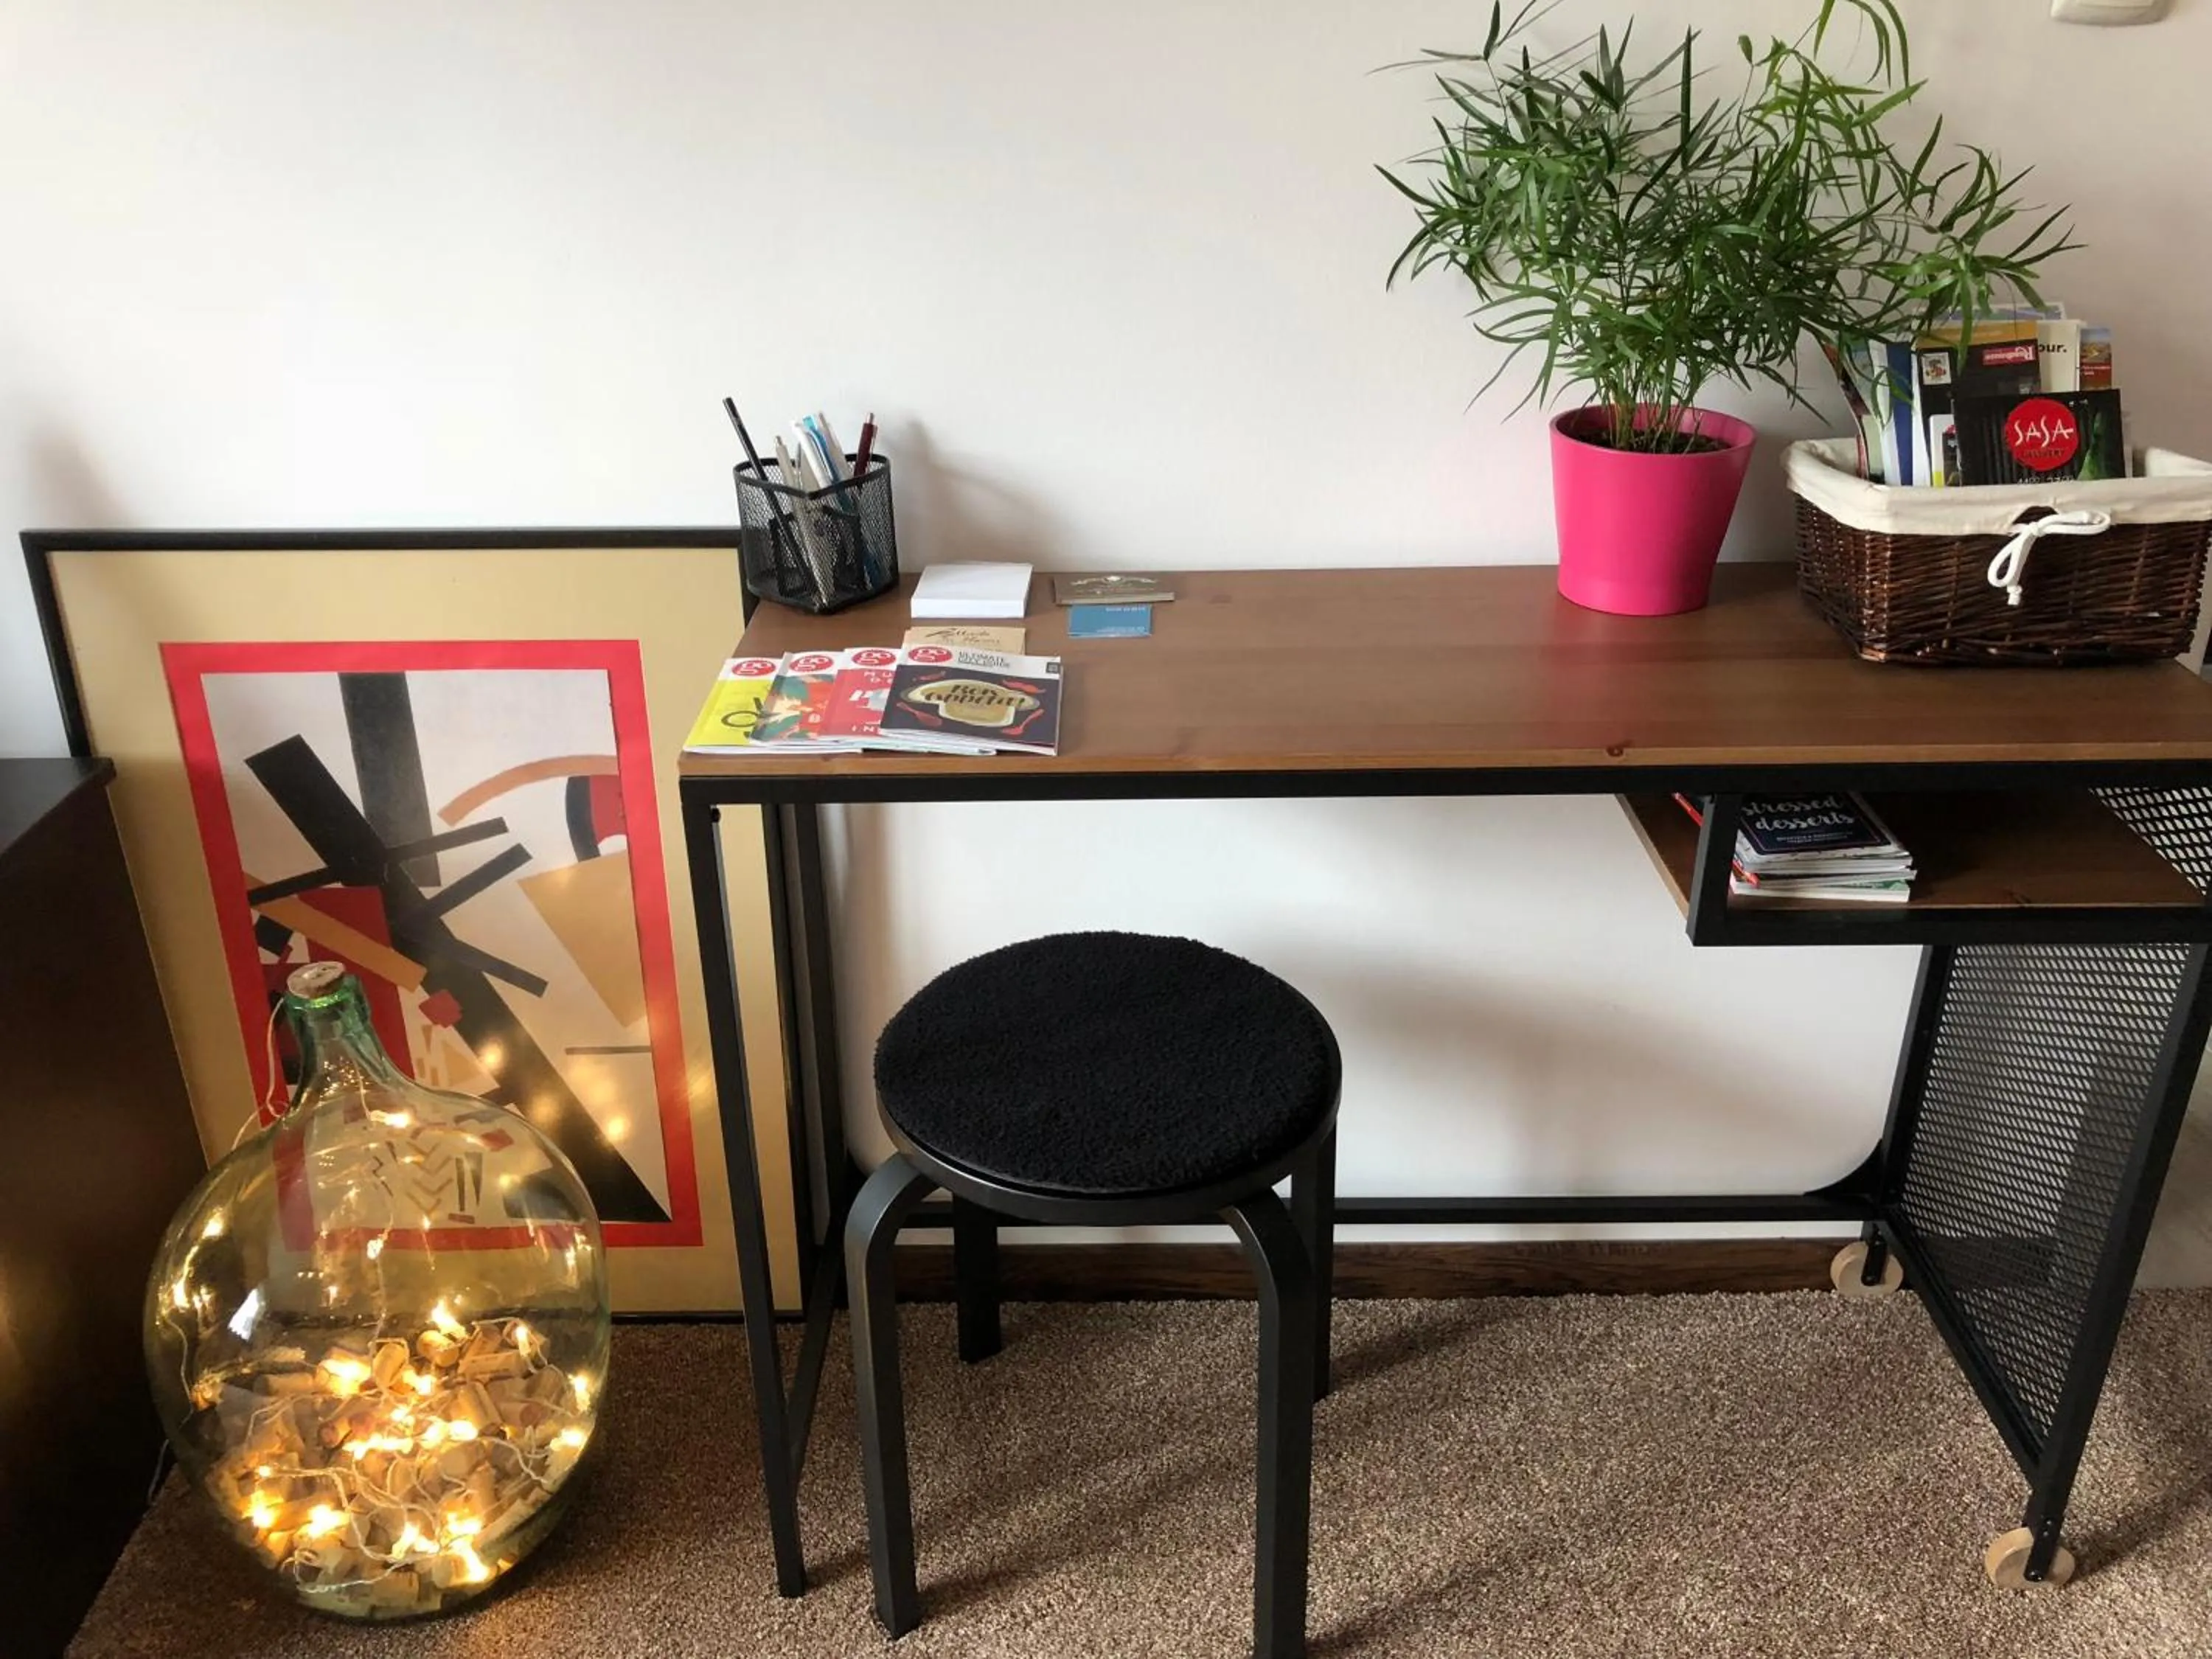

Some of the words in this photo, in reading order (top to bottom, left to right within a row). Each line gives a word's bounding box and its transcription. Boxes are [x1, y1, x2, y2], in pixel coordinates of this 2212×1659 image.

[2014, 415, 2073, 448] SASA
[1741, 796, 1843, 815] stressed
[1755, 812, 1854, 831] desserts
